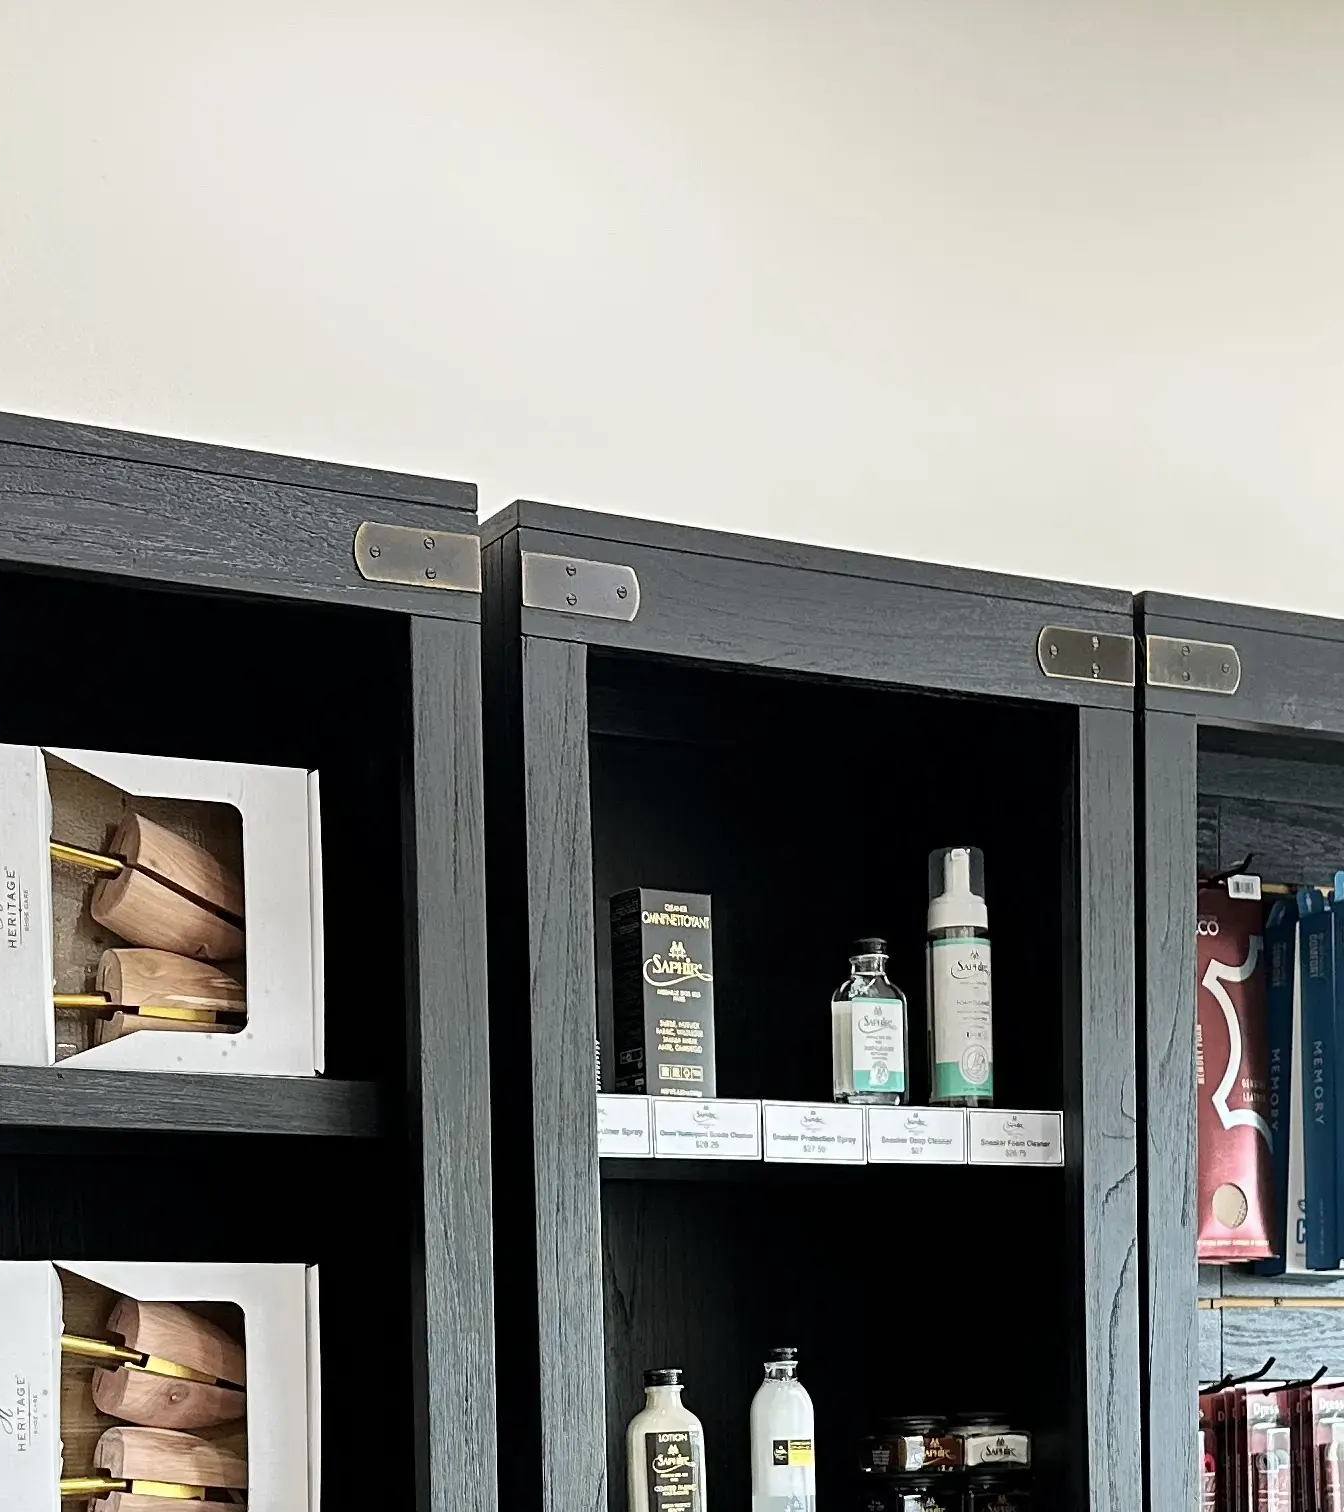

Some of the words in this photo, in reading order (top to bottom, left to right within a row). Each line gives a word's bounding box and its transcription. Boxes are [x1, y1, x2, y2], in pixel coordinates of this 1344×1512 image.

[7, 870, 17, 948] HERITAGE
[1314, 1041, 1324, 1125] MEMORY
[16, 1376, 26, 1451] HERITAGE
[658, 1434, 688, 1442] LOTION
